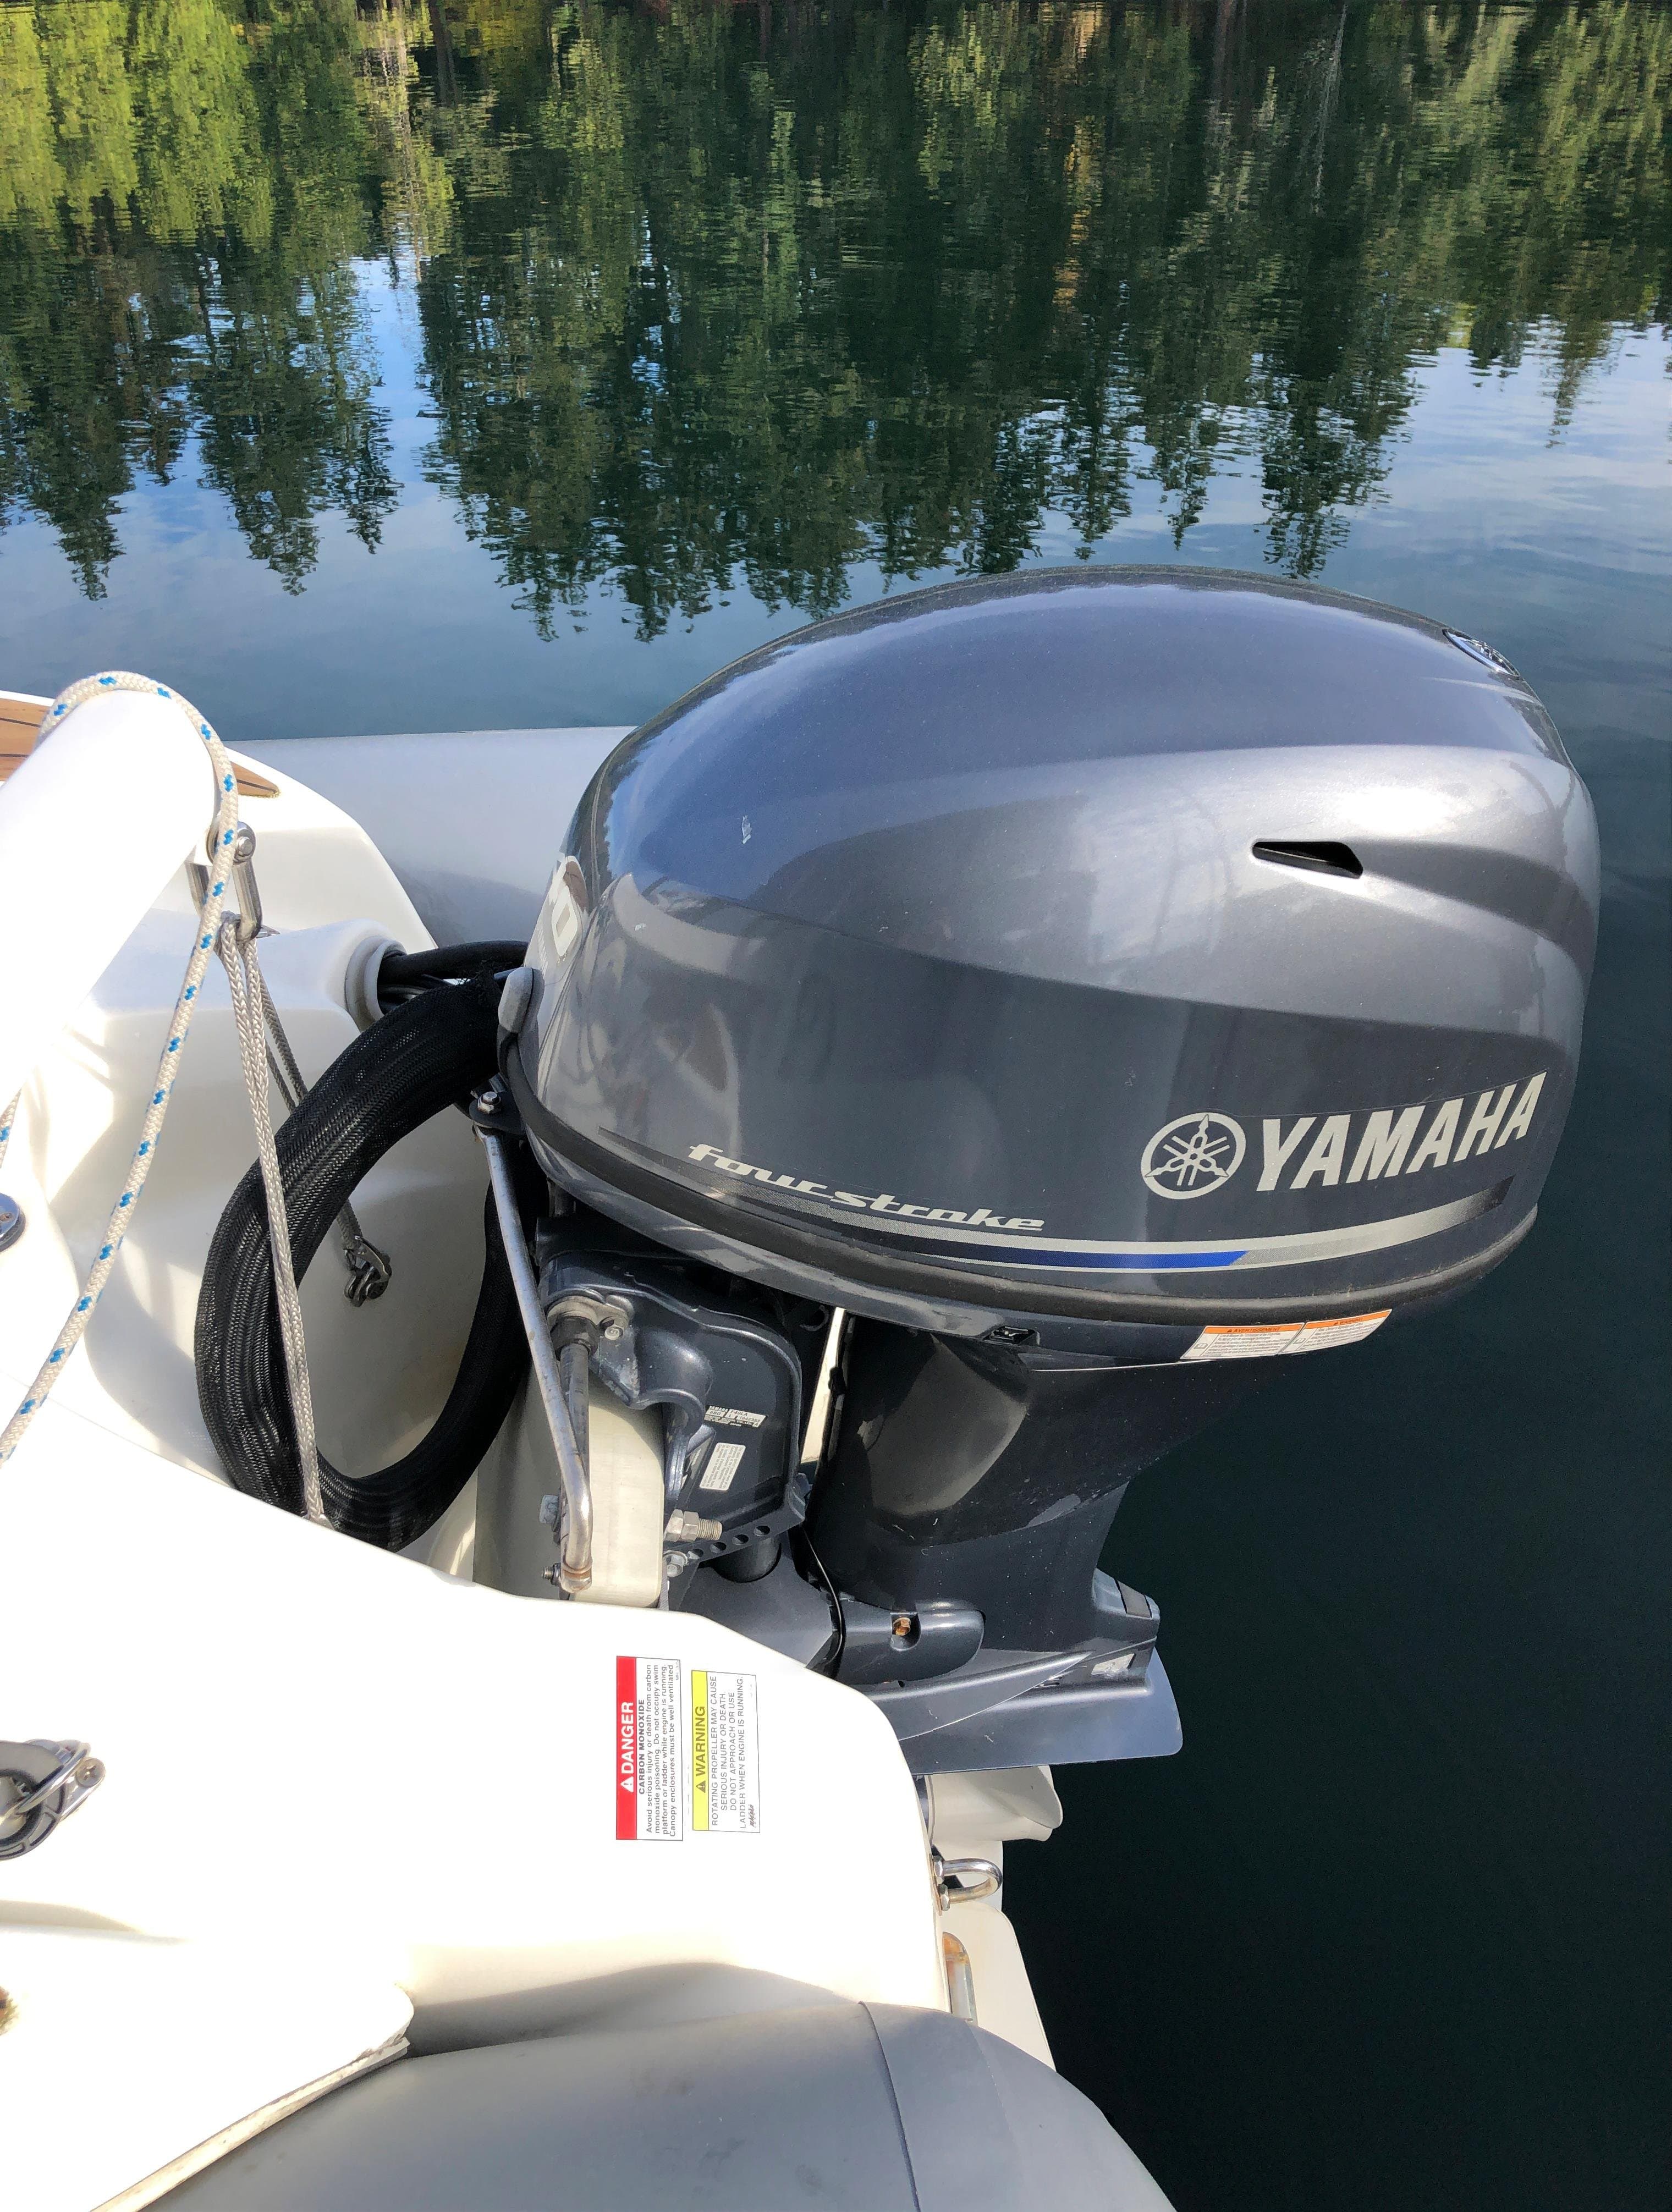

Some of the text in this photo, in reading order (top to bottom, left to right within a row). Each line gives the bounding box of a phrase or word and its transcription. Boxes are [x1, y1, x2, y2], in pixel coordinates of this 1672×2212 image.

[1256, 1071, 1547, 1192] YAMAHA
[729, 1712, 735, 1723] OR
[669, 1723, 675, 1732] be
[719, 1724, 726, 1736] OR
[622, 1702, 634, 1774] DANGER
[647, 1740, 652, 1748] or
[653, 1733, 659, 1745] Do
[695, 1706, 705, 1776] WARNING
[662, 1789, 668, 1797] or
[730, 1799, 736, 1811] DO
[661, 1800, 669, 1835] platform
